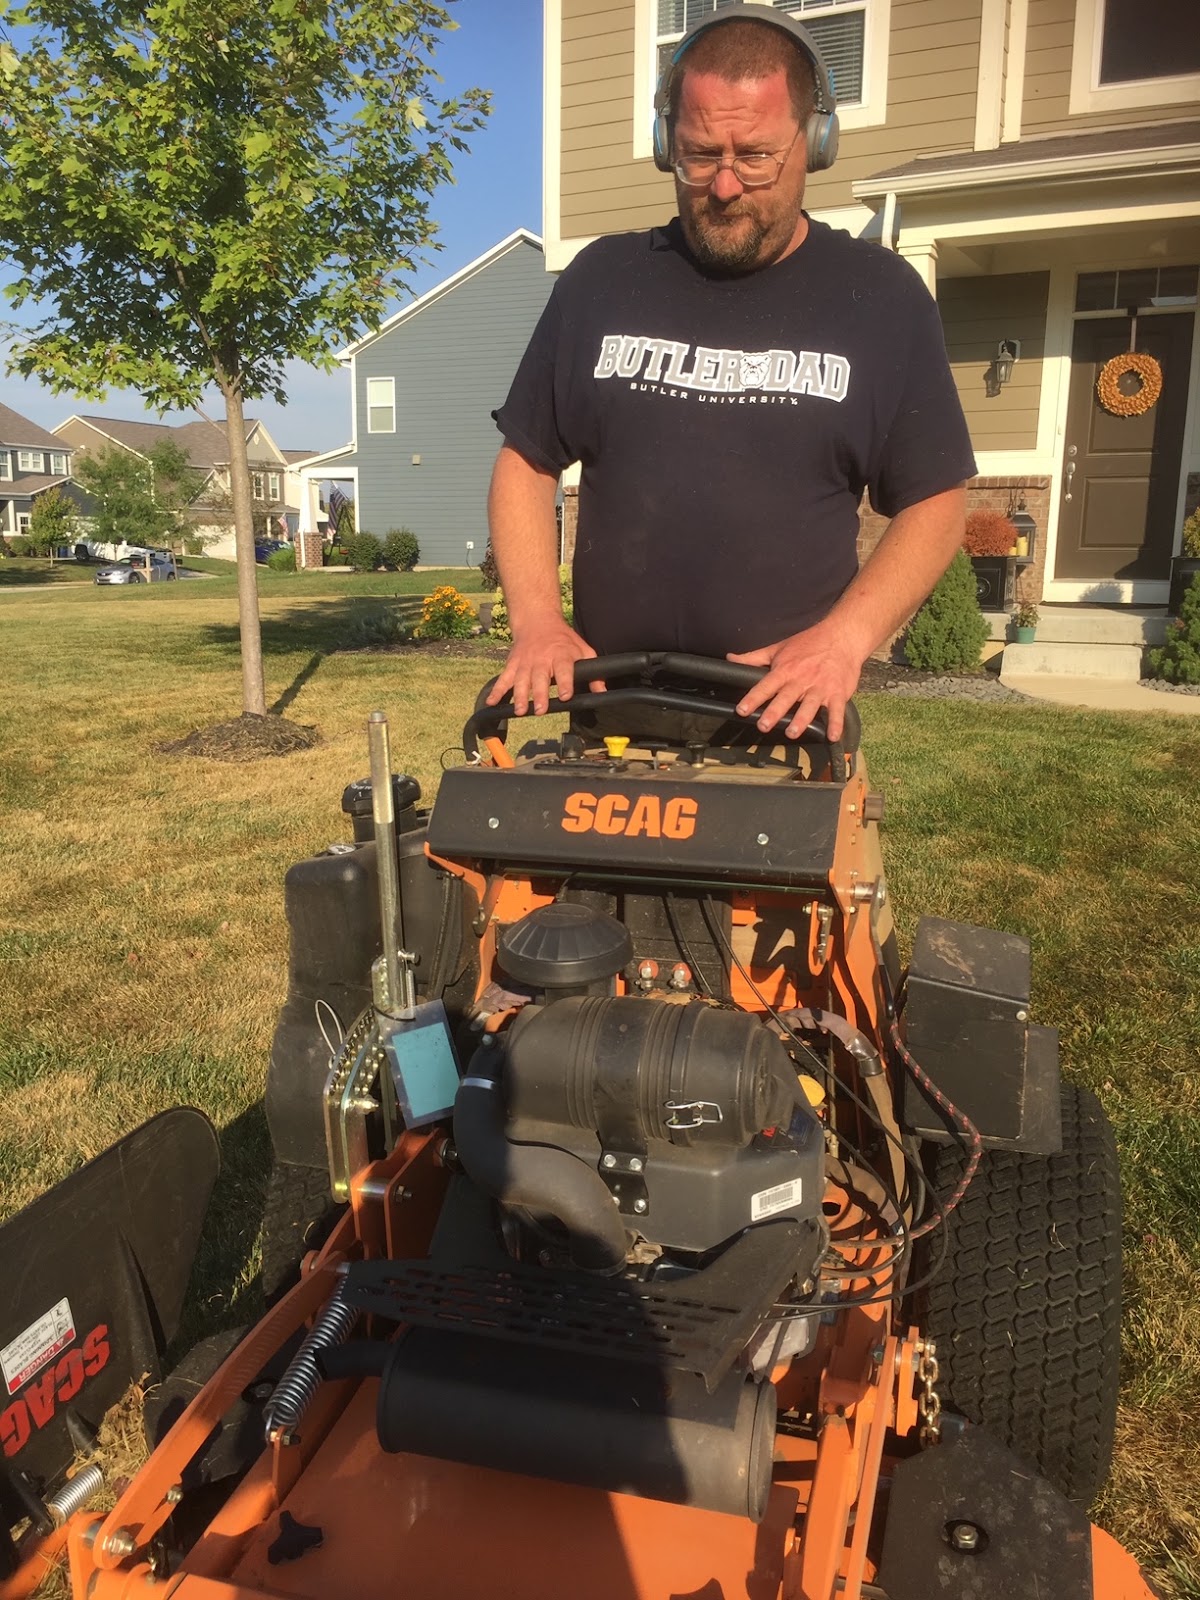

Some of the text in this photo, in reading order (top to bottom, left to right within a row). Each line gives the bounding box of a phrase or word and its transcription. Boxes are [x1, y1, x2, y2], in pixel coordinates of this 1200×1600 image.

[594, 335, 850, 402] BUTLER DAD
[630, 382, 796, 405] BUTLER UNIVERSITY
[561, 792, 698, 839] SCAG
[18, 1345, 55, 1383] DANGER
[0, 1324, 110, 1458] SCAG
